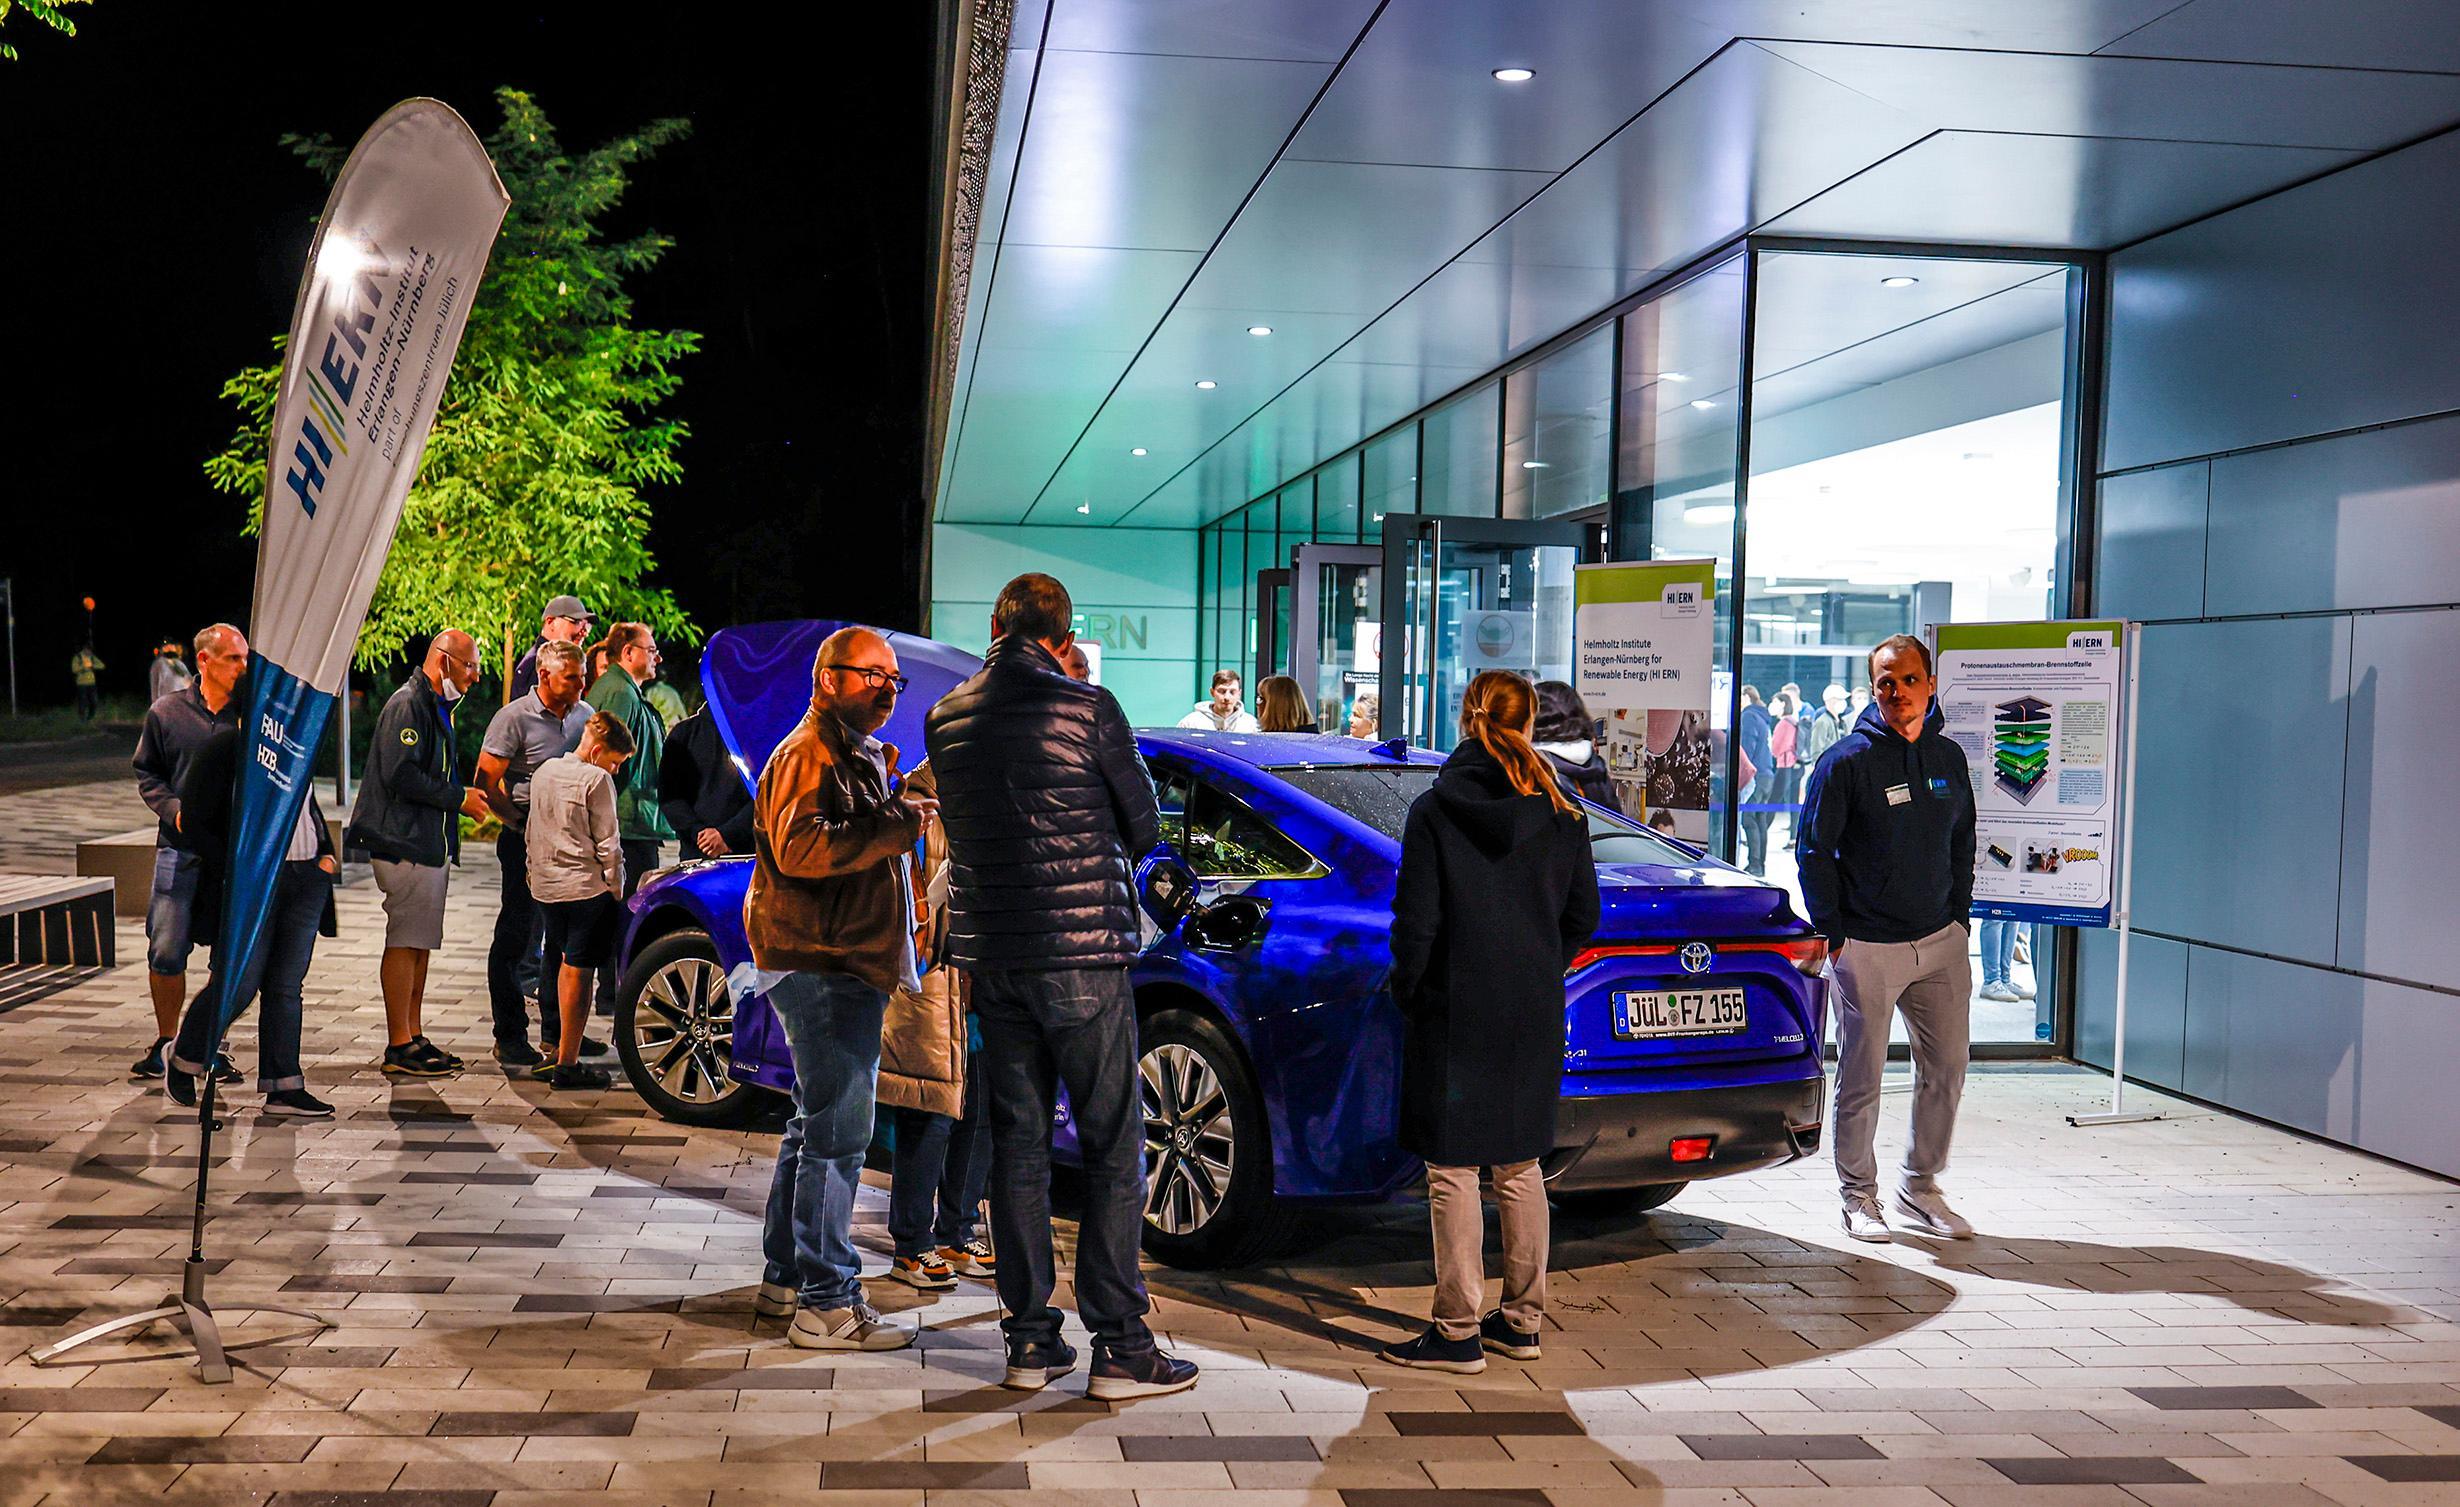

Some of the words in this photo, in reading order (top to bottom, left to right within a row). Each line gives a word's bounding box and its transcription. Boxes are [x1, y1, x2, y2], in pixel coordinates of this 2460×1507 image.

[438, 276, 458, 324] Jülich
[356, 245, 420, 429] Helmholtz-Institut
[367, 252, 436, 445] Erlangen-Nürnberg
[381, 427, 398, 462] part
[394, 405, 403, 426] of
[286, 415, 334, 520] HI
[1667, 593, 1675, 604] HI
[1678, 592, 1694, 604] ERN
[1583, 639, 1620, 650] Helmholtz
[1621, 638, 1652, 649] Institute
[2072, 639, 2082, 648] HI
[2085, 638, 2103, 648] ERN
[1583, 654, 1650, 667] Erlangen-Nürnberg
[1651, 653, 1663, 664] for
[1344, 676, 1380, 684] Wissenscha
[1583, 669, 1621, 680] Renewable
[1623, 669, 1648, 682] Energy
[1649, 669, 1661, 682] (HI
[1662, 669, 1681, 682] ERN)
[261, 713, 284, 745] FAU
[256, 743, 278, 772] HZB
[1619, 1017, 1626, 1027] D
[1629, 996, 1668, 1028] JÜL
[1680, 994, 1706, 1025] FZ
[1710, 993, 1744, 1024] 155
